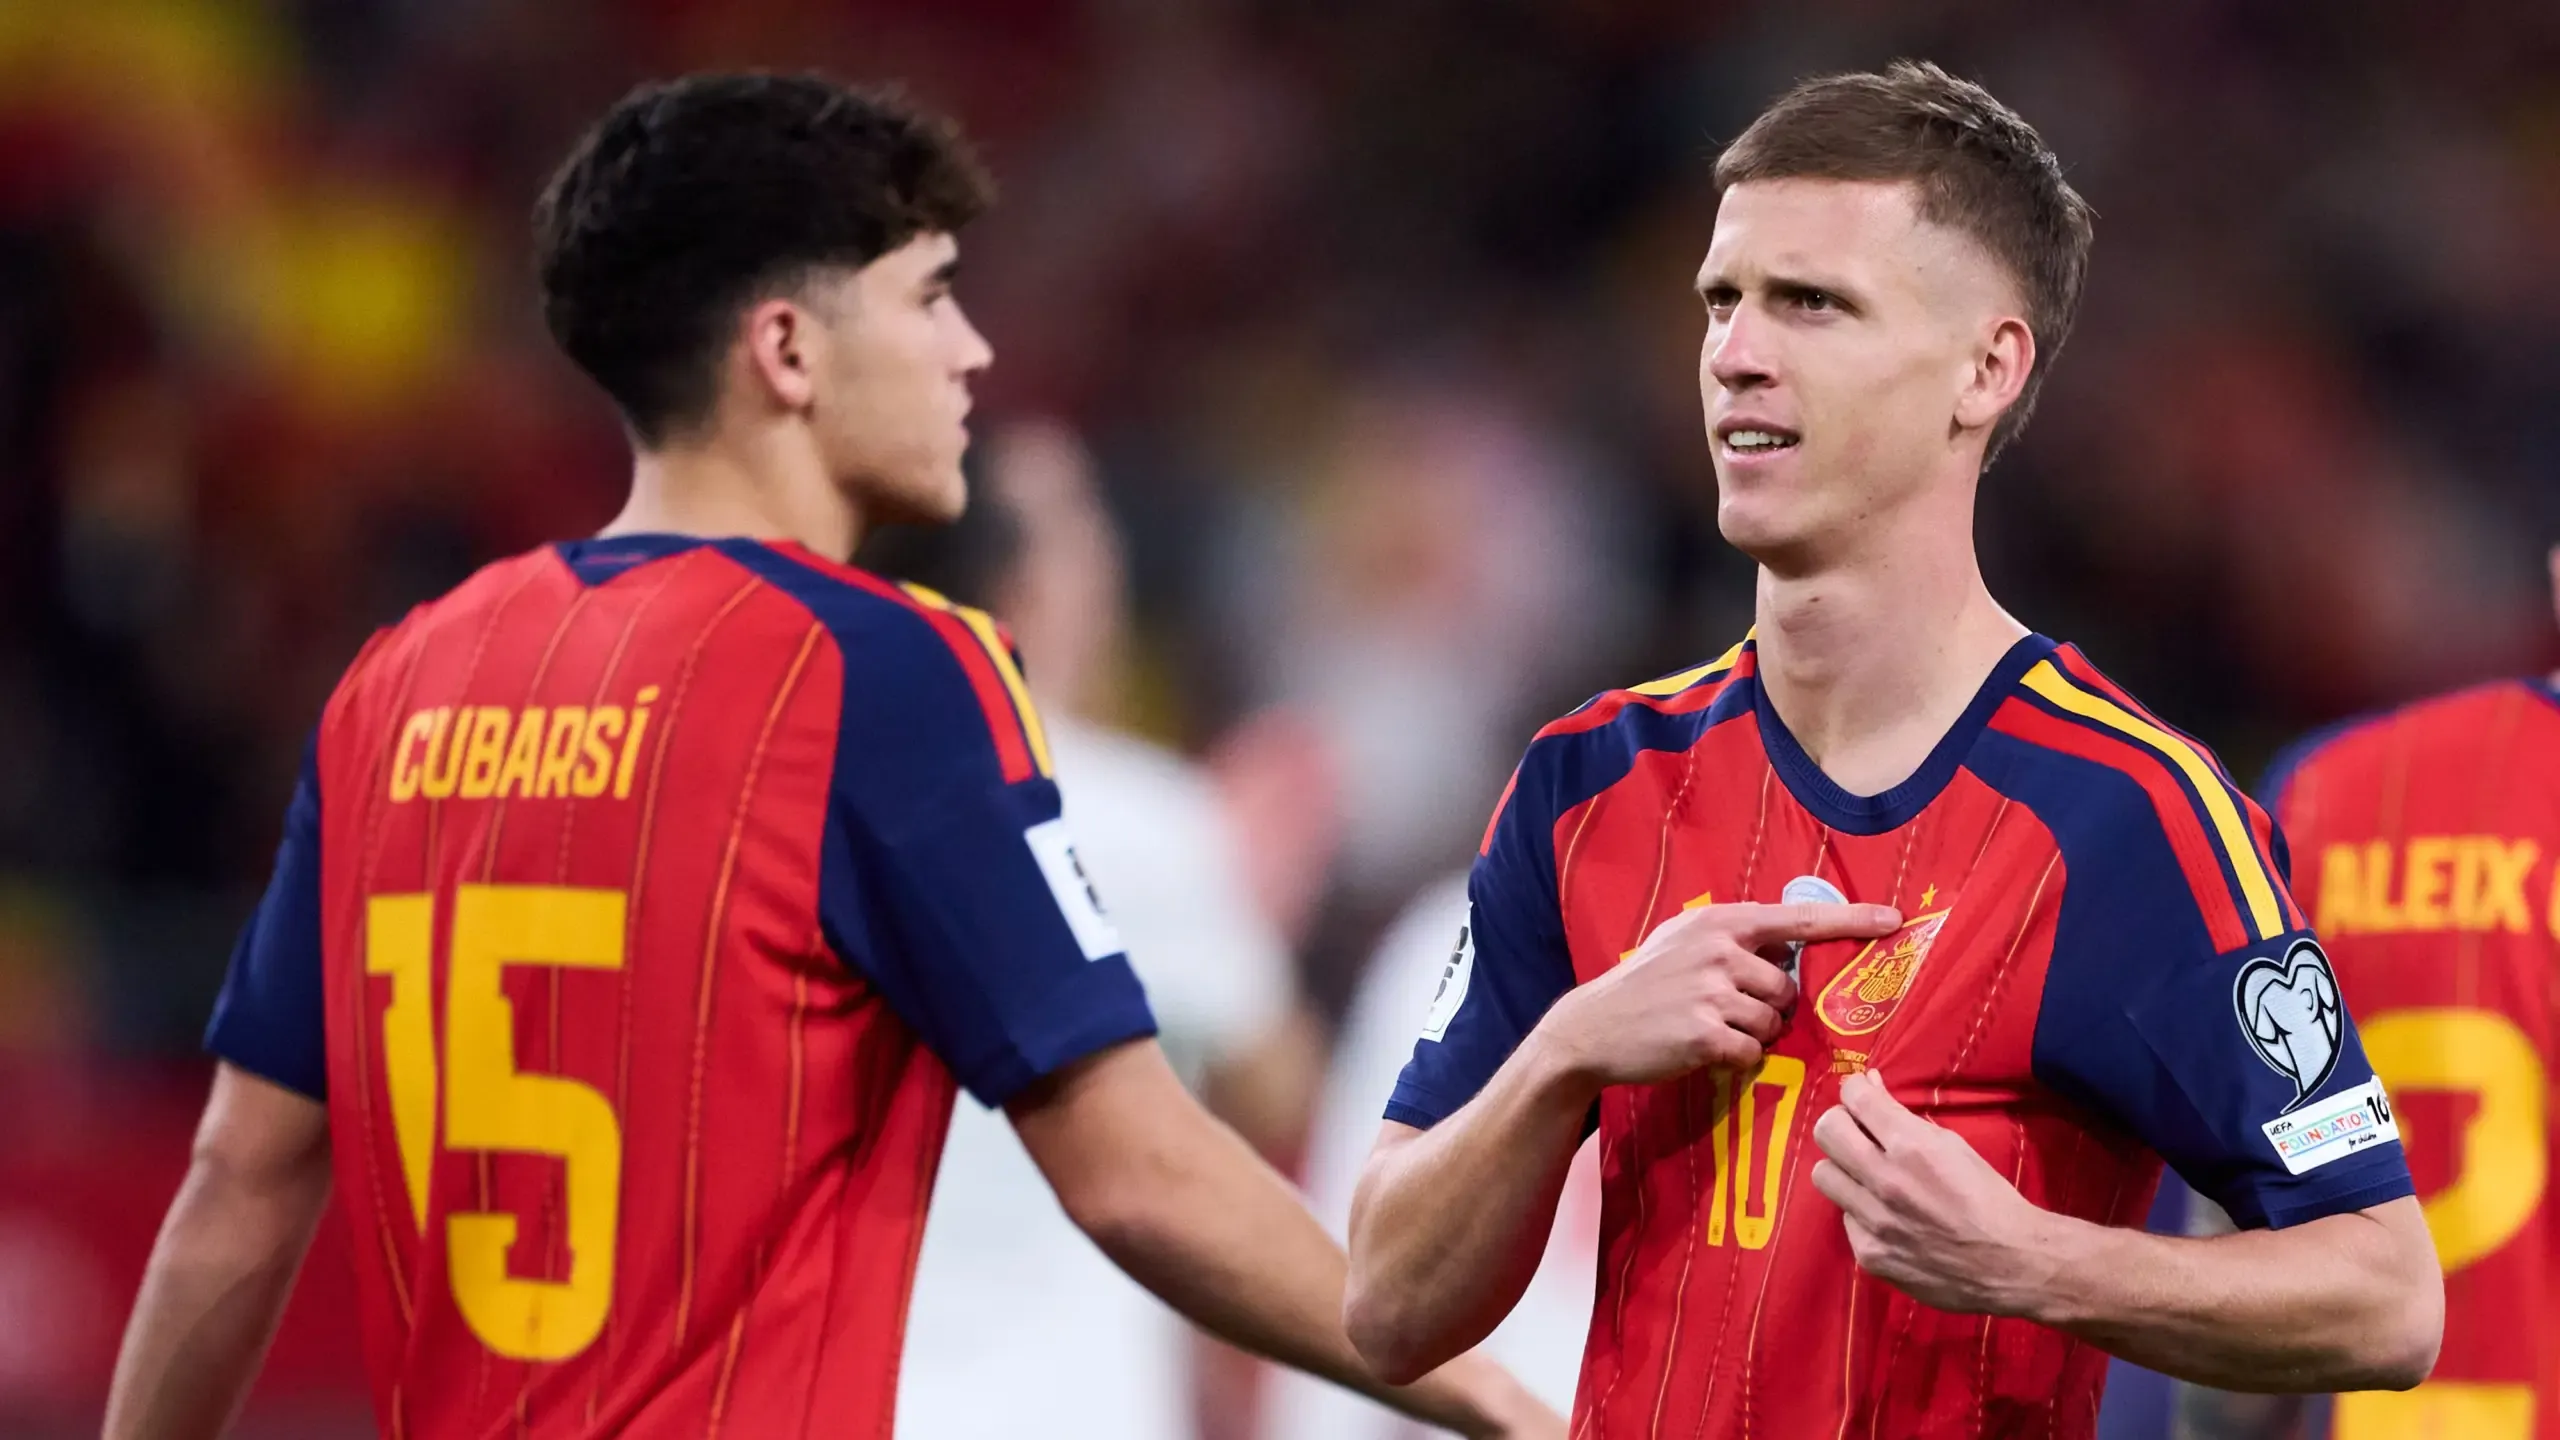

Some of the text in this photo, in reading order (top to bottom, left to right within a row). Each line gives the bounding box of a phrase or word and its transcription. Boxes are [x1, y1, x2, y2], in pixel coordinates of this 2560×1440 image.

[390, 685, 660, 803] CUBARSÍ
[2316, 834, 2541, 939] ALEIX
[366, 884, 627, 1363] 15
[1707, 1054, 1806, 1249] 10
[2269, 1121, 2294, 1136] UEFA
[2279, 1109, 2371, 1153] FOUNDATION
